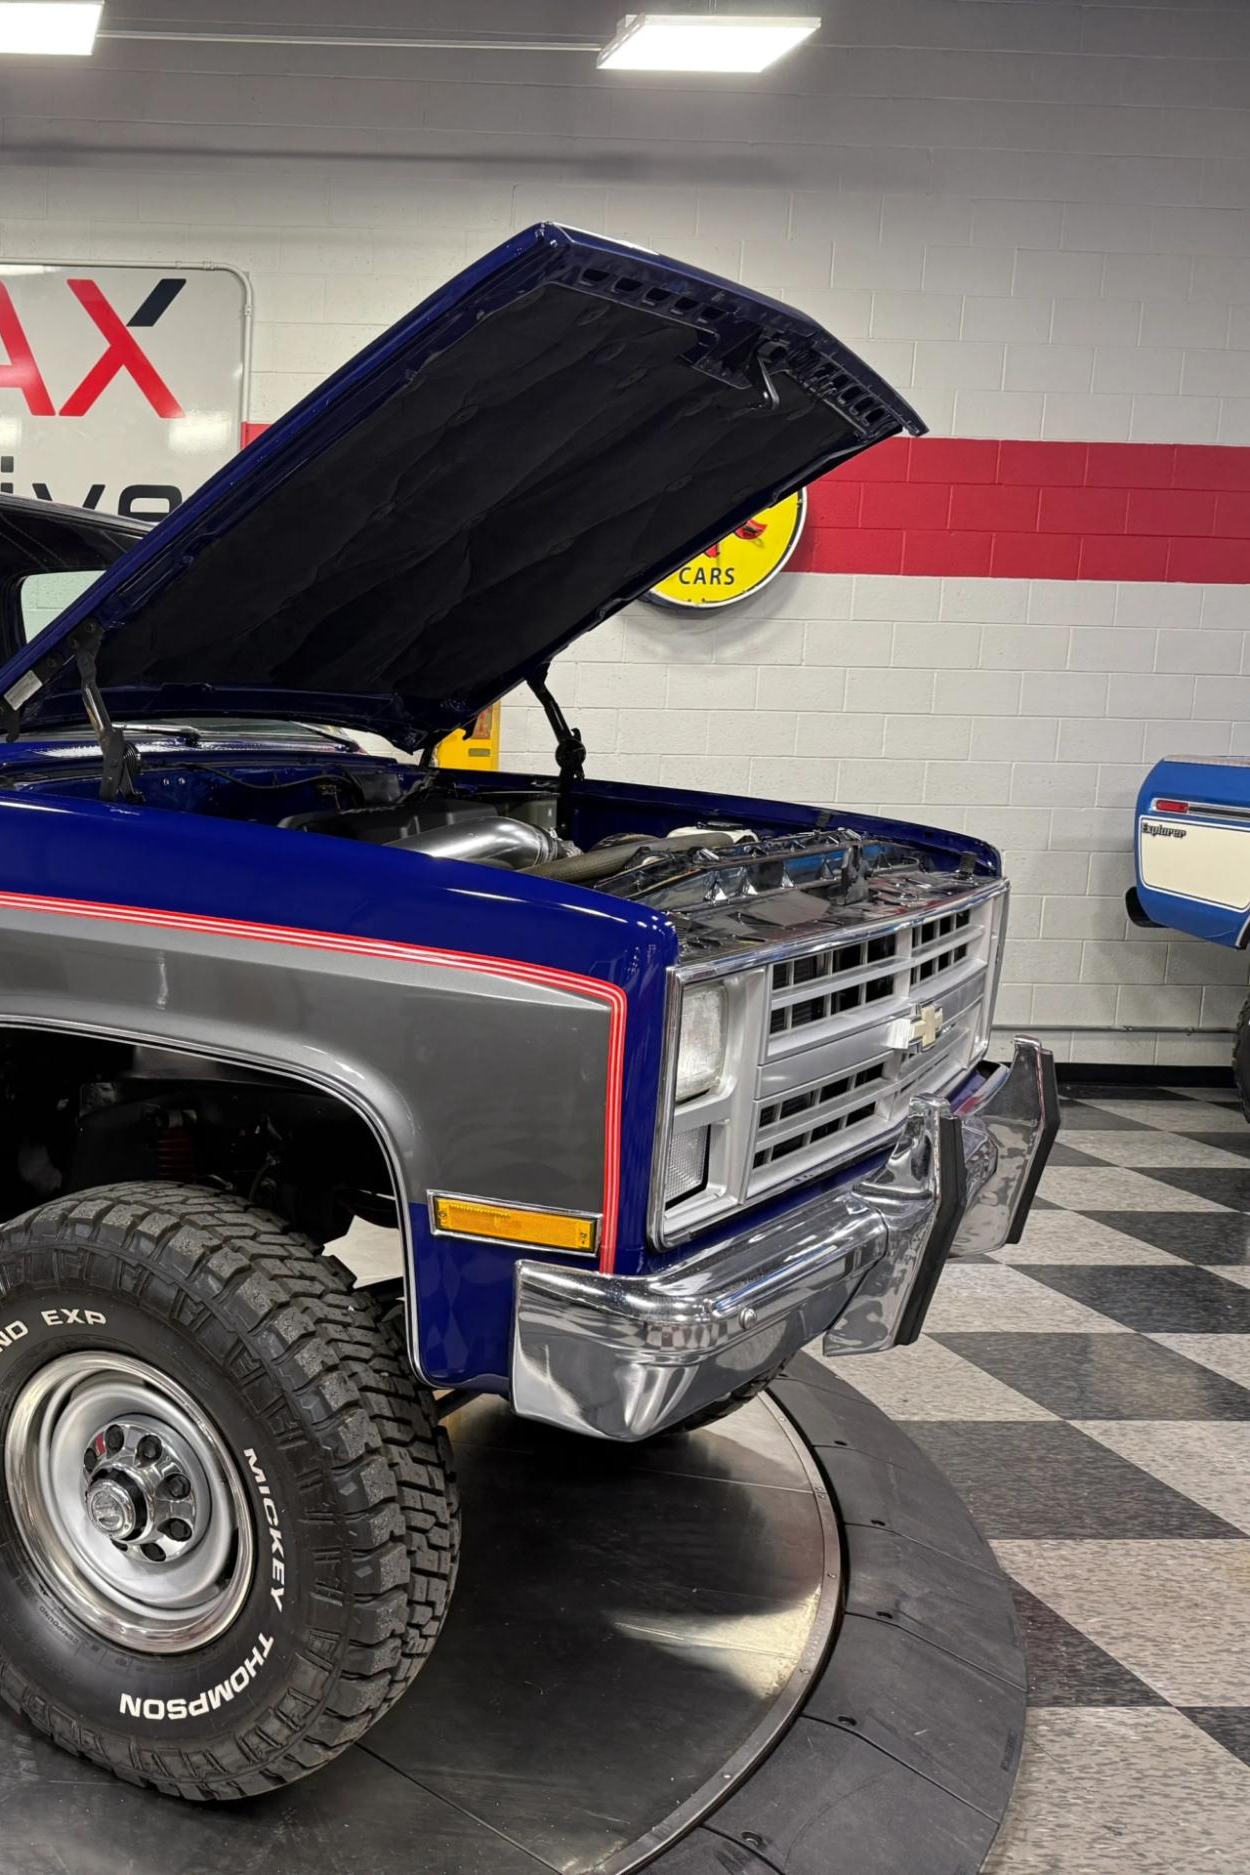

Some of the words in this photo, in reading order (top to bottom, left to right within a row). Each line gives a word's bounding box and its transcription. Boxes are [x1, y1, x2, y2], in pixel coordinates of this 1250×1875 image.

[679, 567, 735, 586] CARS
[1142, 822, 1186, 840] Explorer
[41, 1308, 108, 1327] EXP
[243, 1448, 285, 1612] MICKEY
[119, 1632, 275, 1720] THOMPSON
